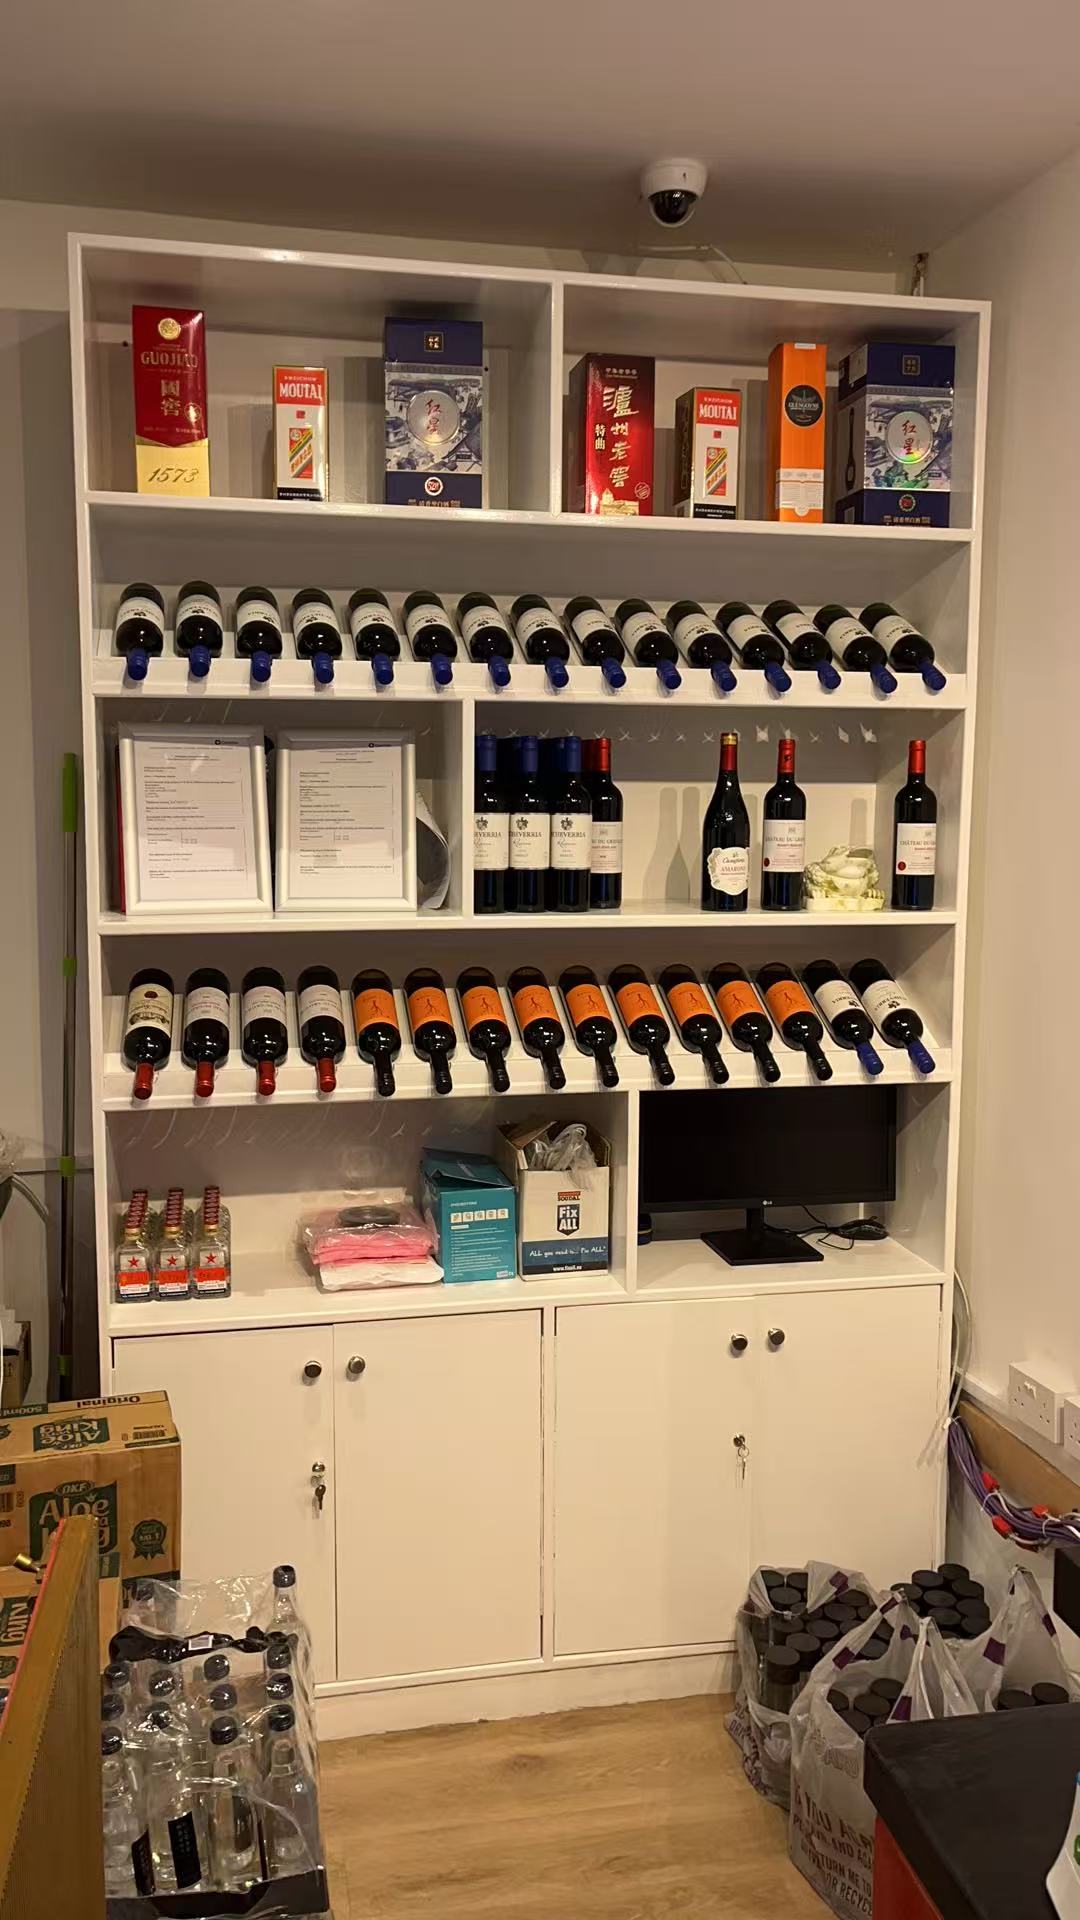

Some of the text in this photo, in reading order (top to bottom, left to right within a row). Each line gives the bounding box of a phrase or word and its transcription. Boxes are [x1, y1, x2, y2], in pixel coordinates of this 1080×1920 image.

[141, 351, 199, 367] GUOJIAO
[279, 382, 323, 400] MOUTAI
[699, 404, 738, 420] MOUTAI
[594, 423, 606, 451] 特曲
[901, 420, 917, 456] 红星
[147, 467, 200, 483] 1573
[559, 1206, 578, 1219] Fix
[559, 1218, 578, 1231] ALL
[530, 1249, 544, 1257] ALL
[77, 1395, 141, 1408] Original
